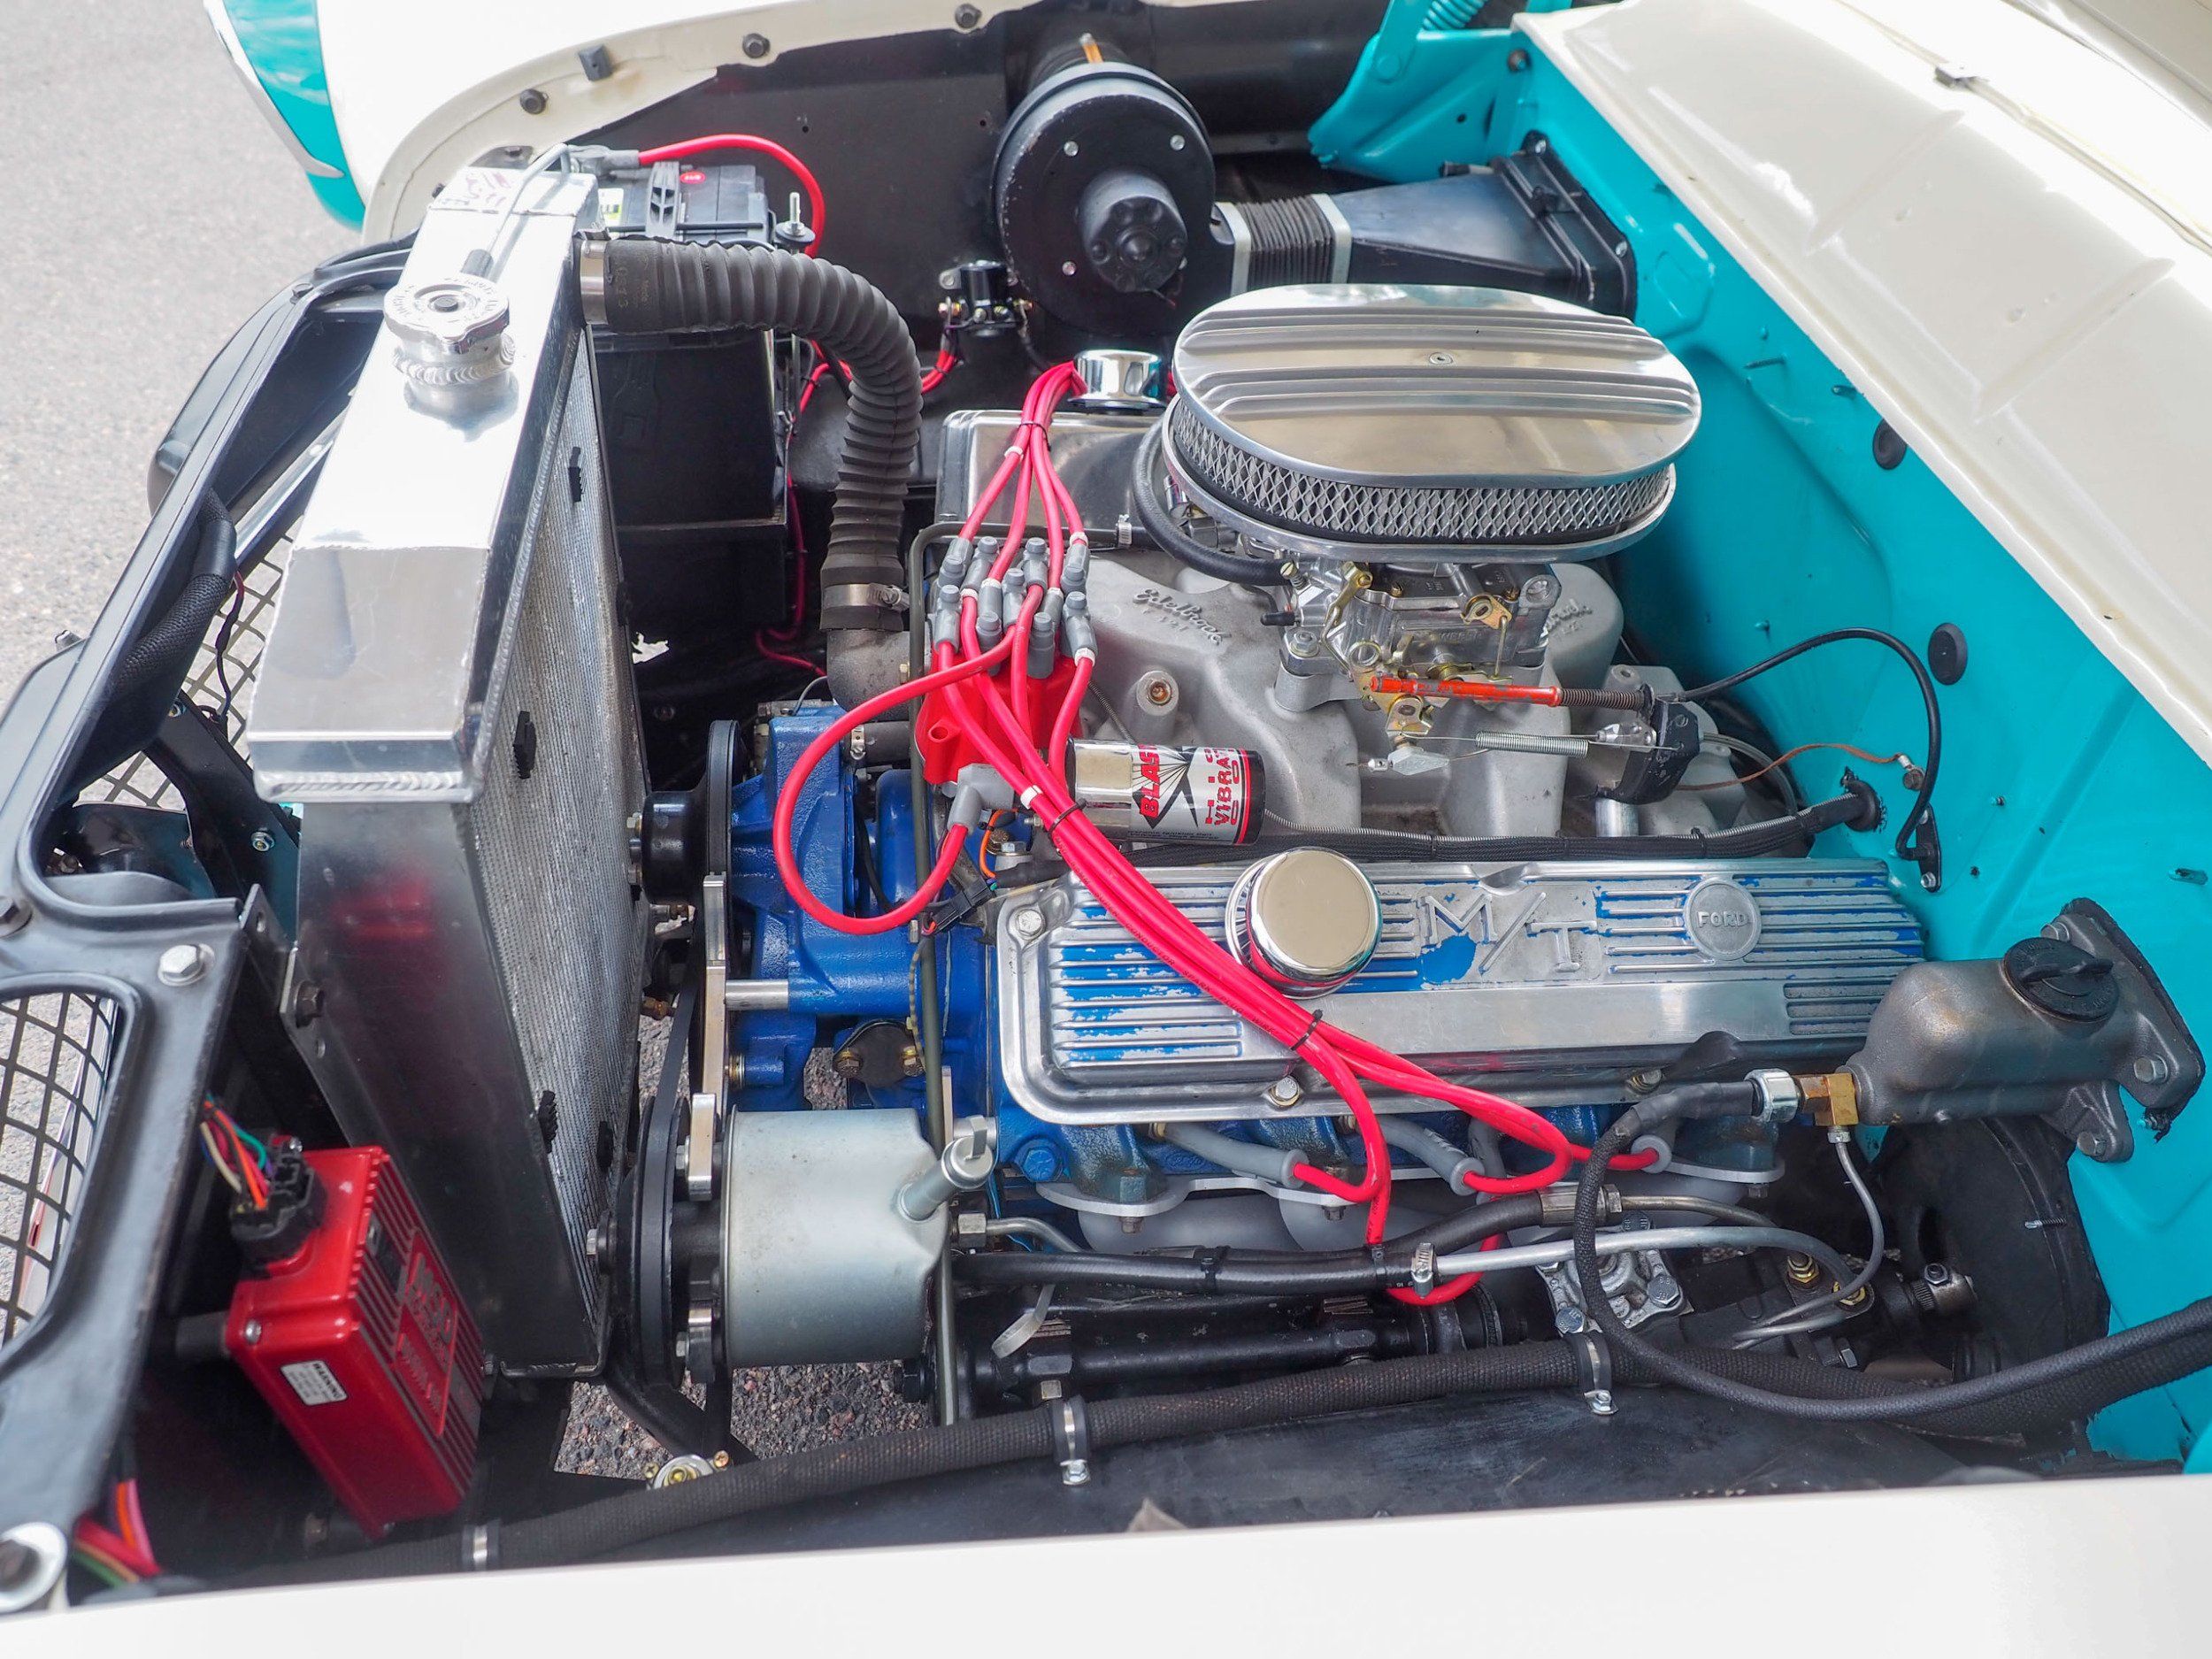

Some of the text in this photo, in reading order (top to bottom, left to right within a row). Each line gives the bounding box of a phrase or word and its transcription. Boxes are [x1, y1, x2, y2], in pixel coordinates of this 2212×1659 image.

[1133, 589, 1232, 646] Edelbrock
[1420, 892, 1598, 974] M/T
[1697, 910, 1750, 928] FORD
[1125, 922, 1175, 966] CONDUCTOR
[1181, 969, 1211, 992] SPARK
